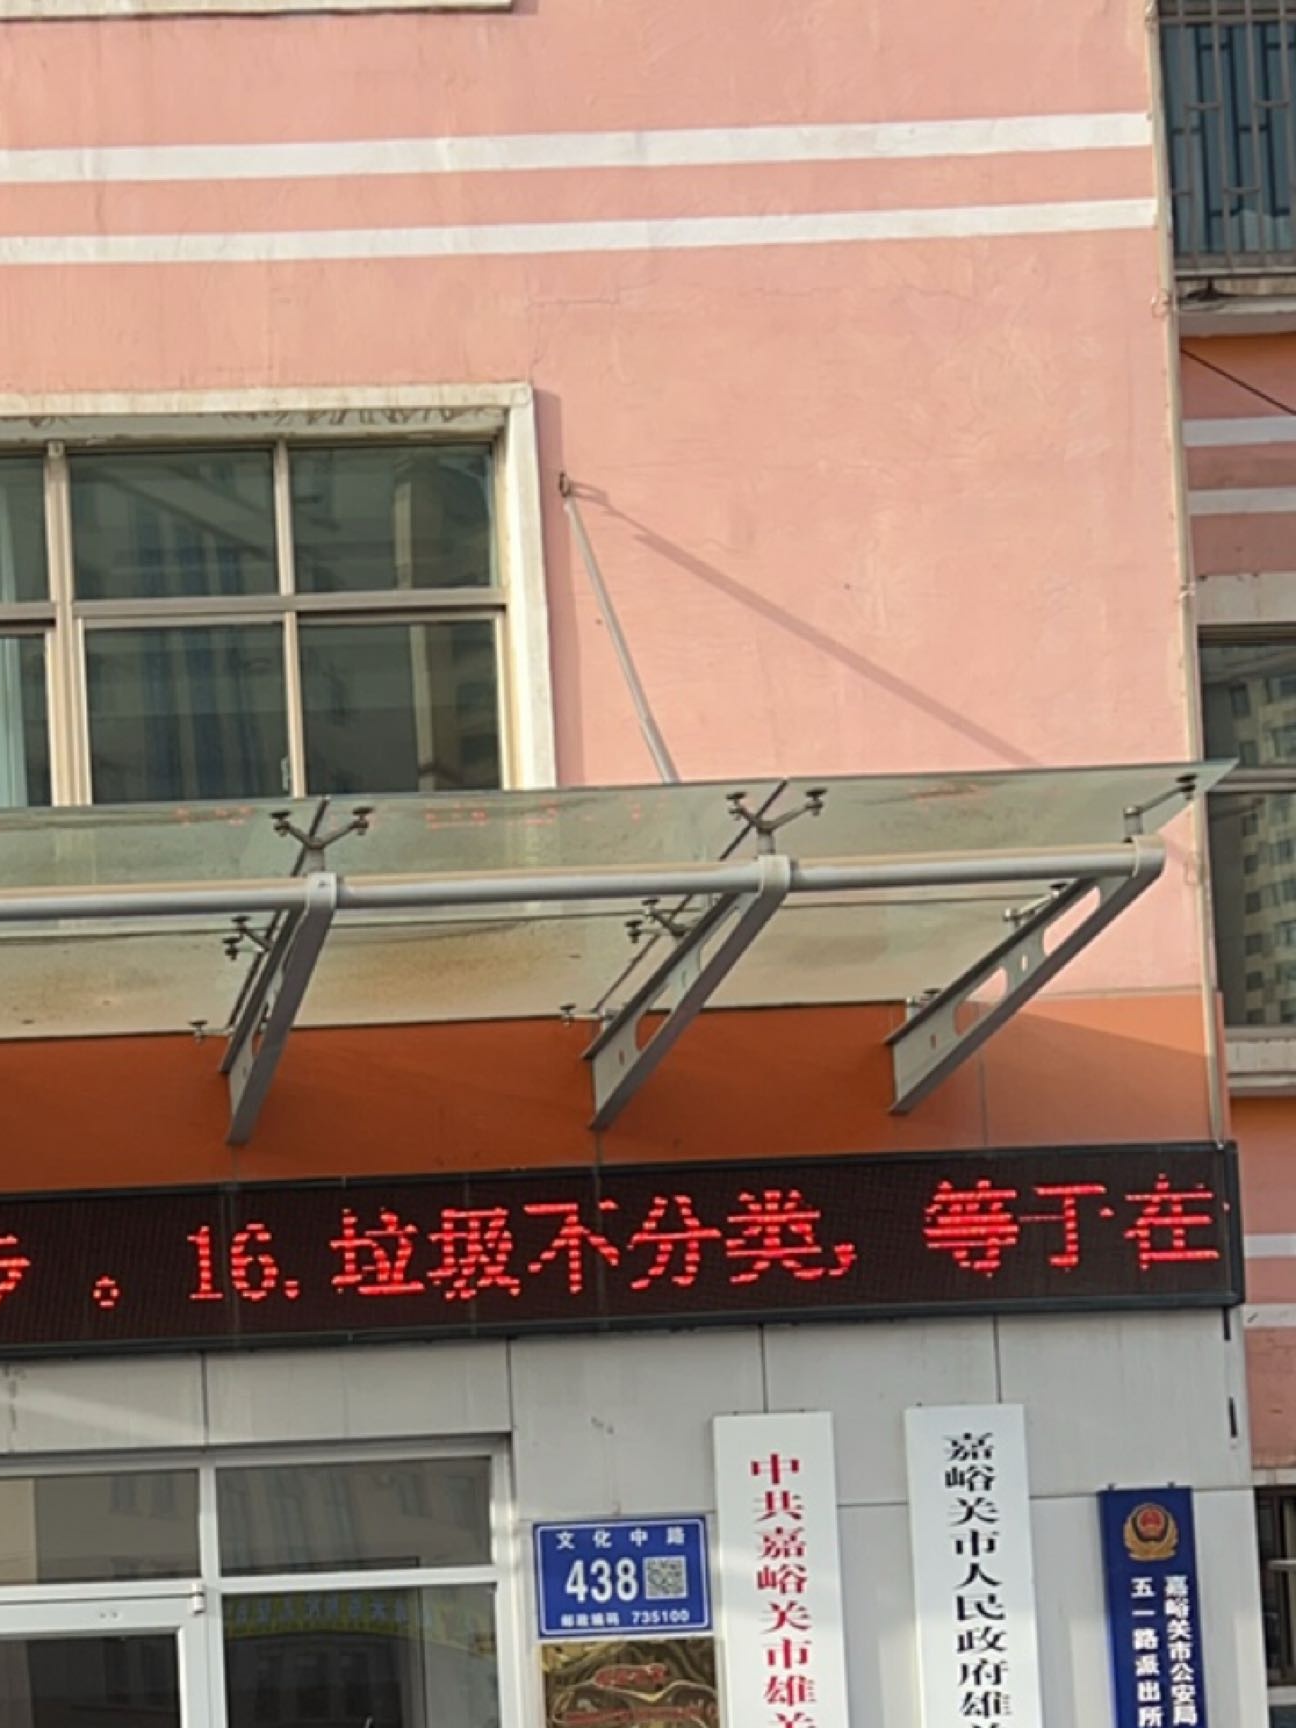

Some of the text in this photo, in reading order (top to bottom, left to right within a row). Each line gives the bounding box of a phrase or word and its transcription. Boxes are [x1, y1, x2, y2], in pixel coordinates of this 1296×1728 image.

[555, 1526, 686, 1551] 文化中路
[565, 1557, 639, 1604] 438
[631, 1608, 692, 1625] 735100
[1130, 1576, 1163, 1728] 五一路派出所
[1164, 1574, 1199, 1727] 嘉峪关市公安局
